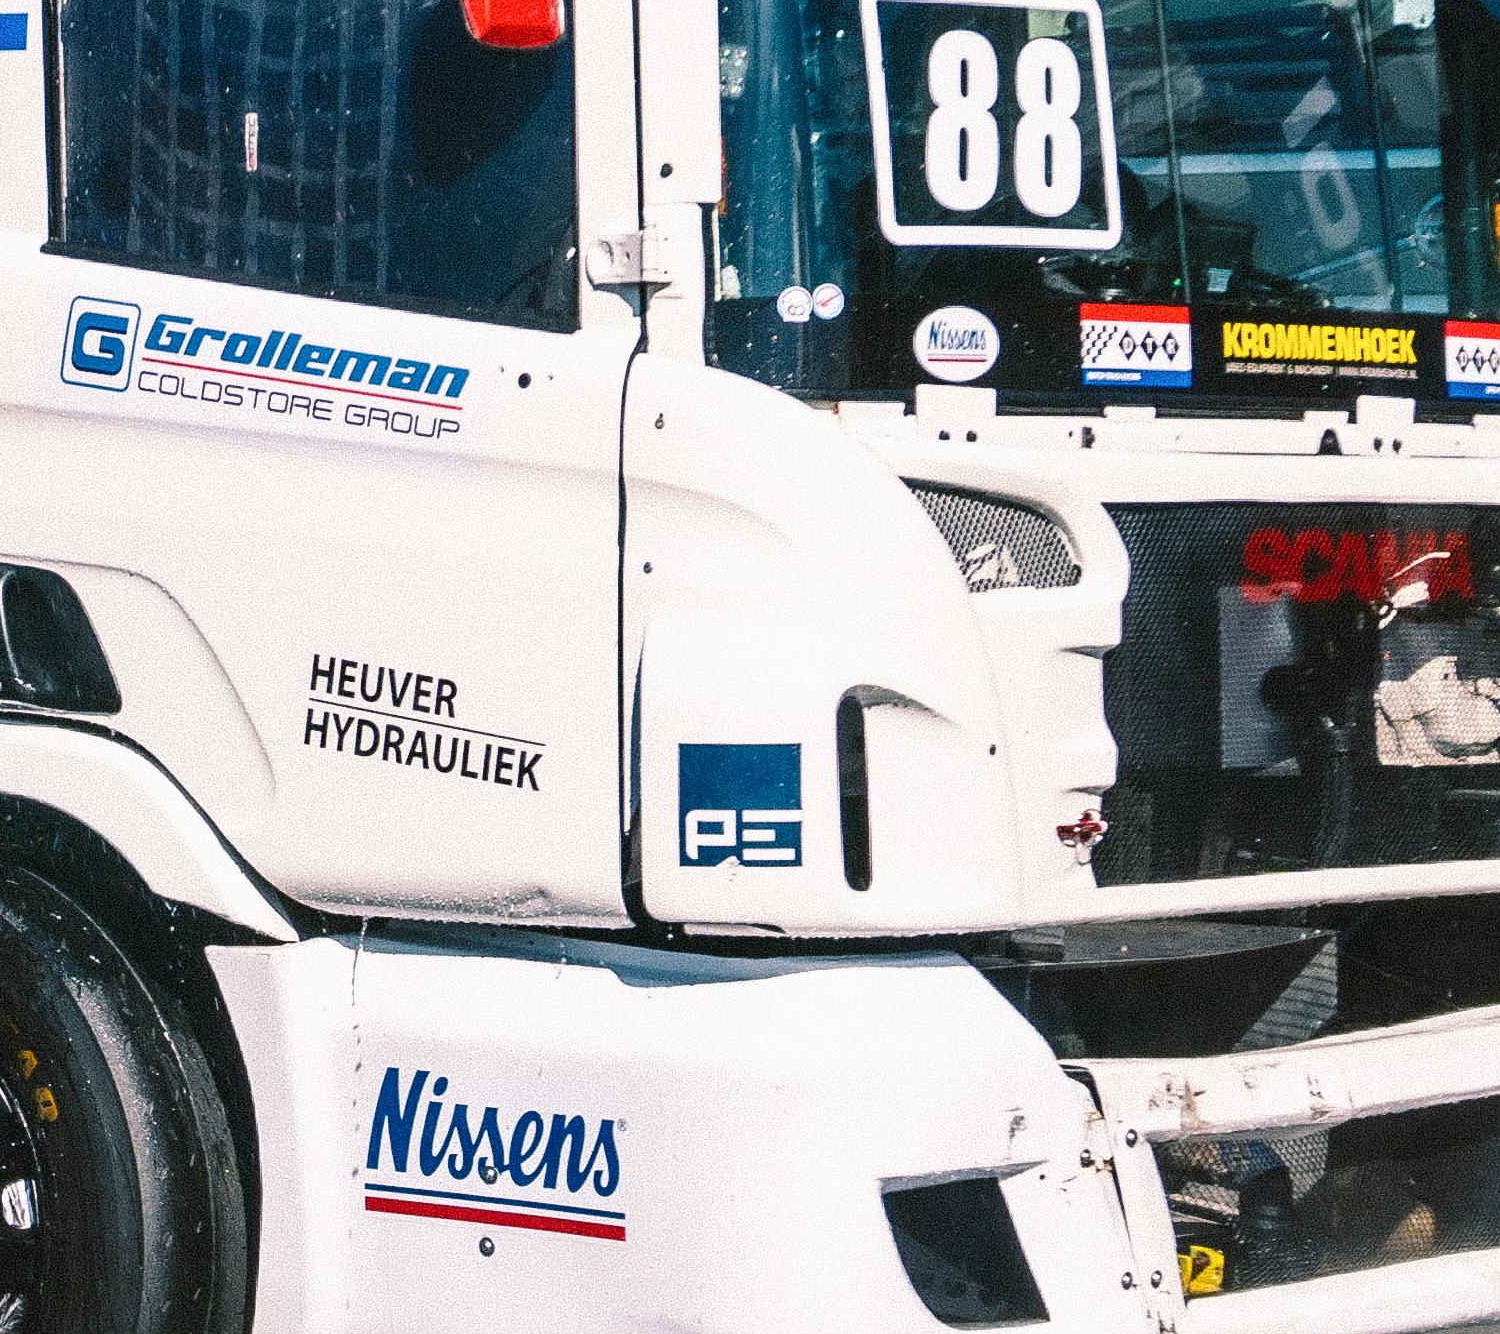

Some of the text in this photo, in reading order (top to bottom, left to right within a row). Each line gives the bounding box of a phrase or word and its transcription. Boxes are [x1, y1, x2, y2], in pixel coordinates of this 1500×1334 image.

[923, 28, 1083, 220] 88
[143, 313, 471, 401] Grolleman
[926, 319, 989, 351] Nissens
[1221, 321, 1418, 365] KROMMENHOEK
[136, 369, 461, 442] COLDSTORE GROUP
[1239, 524, 1476, 607] SCANIA
[310, 653, 459, 722] HEUVER
[301, 709, 544, 793] HYDRAULIEK
[366, 1066, 622, 1199] Nissens
